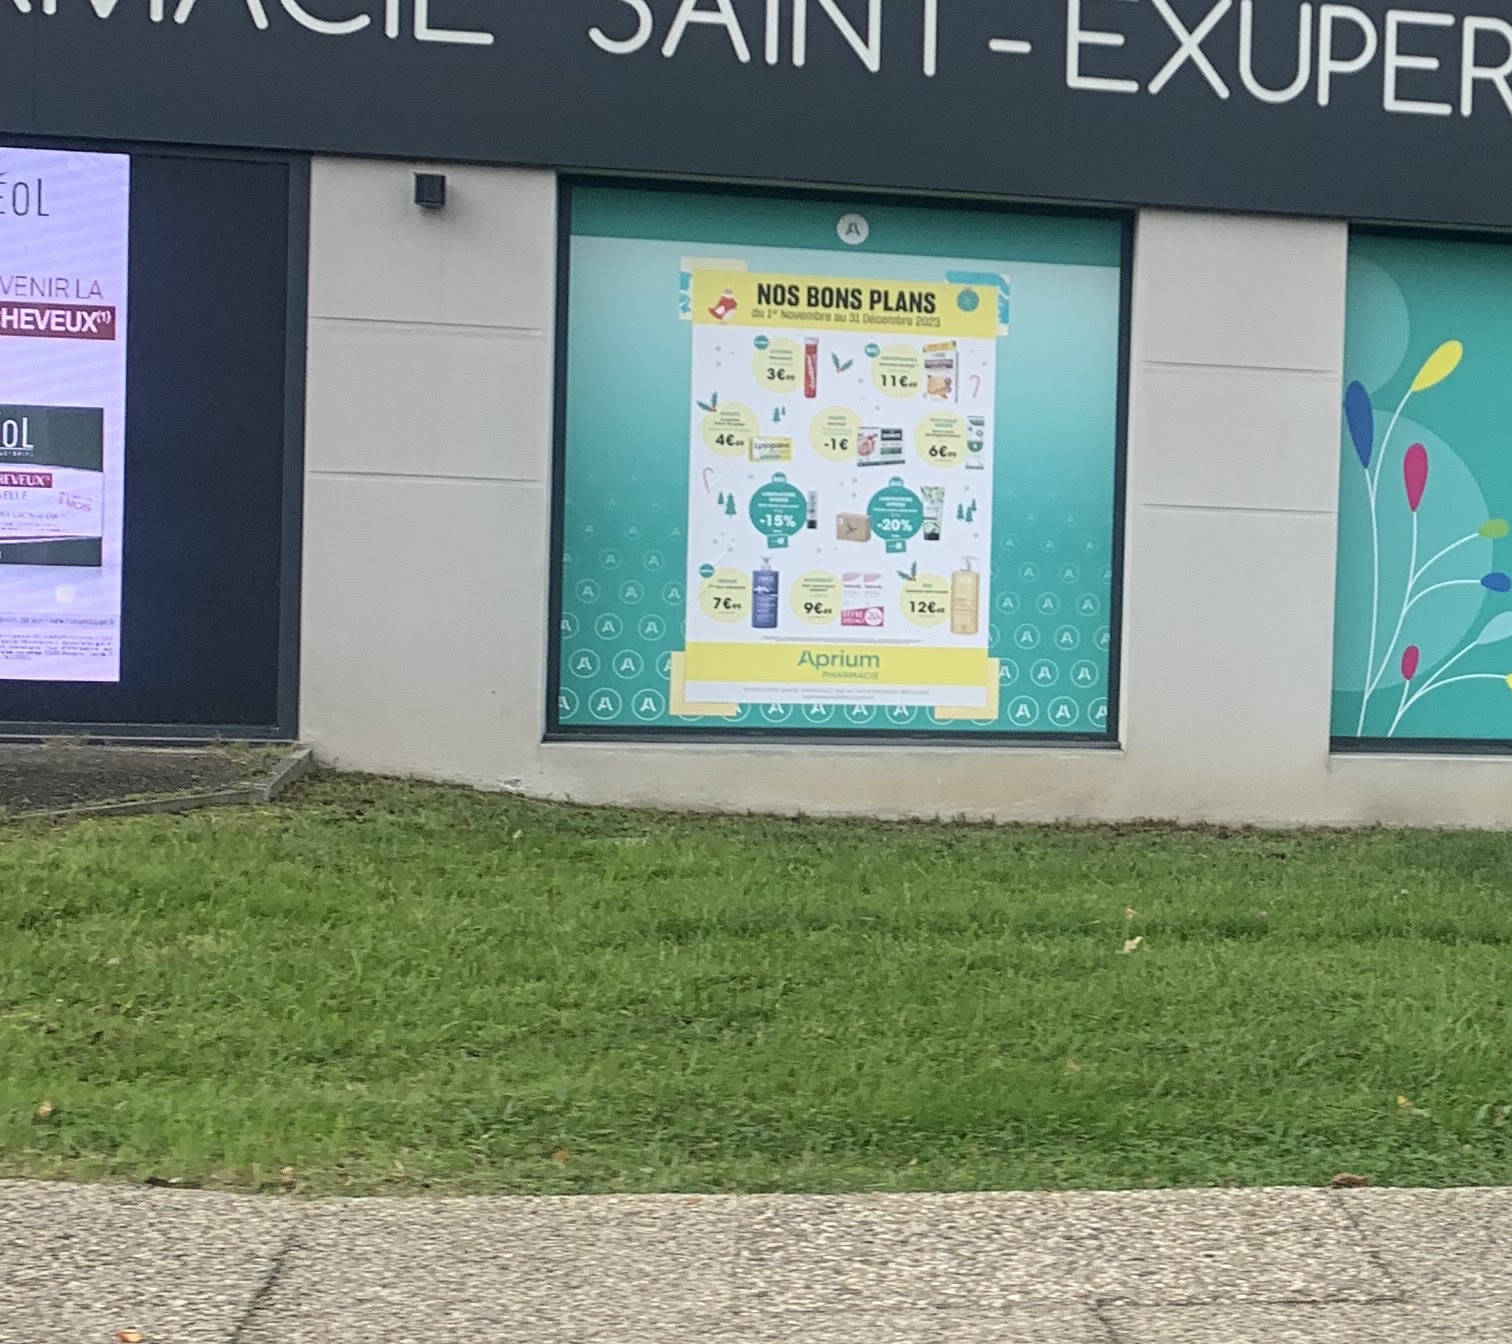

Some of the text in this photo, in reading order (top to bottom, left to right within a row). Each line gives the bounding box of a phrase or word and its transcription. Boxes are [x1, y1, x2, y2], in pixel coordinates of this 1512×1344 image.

[0, 275, 104, 300] VENIR LA
[757, 283, 937, 314] NOS BONS PLANS
[752, 308, 765, 318] du
[780, 309, 832, 322] Novembre
[834, 313, 847, 322] au
[849, 312, 861, 323] 31
[863, 312, 914, 326] Décembre
[915, 316, 942, 328] 2023
[824, 438, 849, 450] -1€
[759, 514, 797, 528] -15%
[877, 518, 913, 532] -20%
[797, 649, 880, 670] Aprium
[823, 671, 878, 680] PHARMACIE
